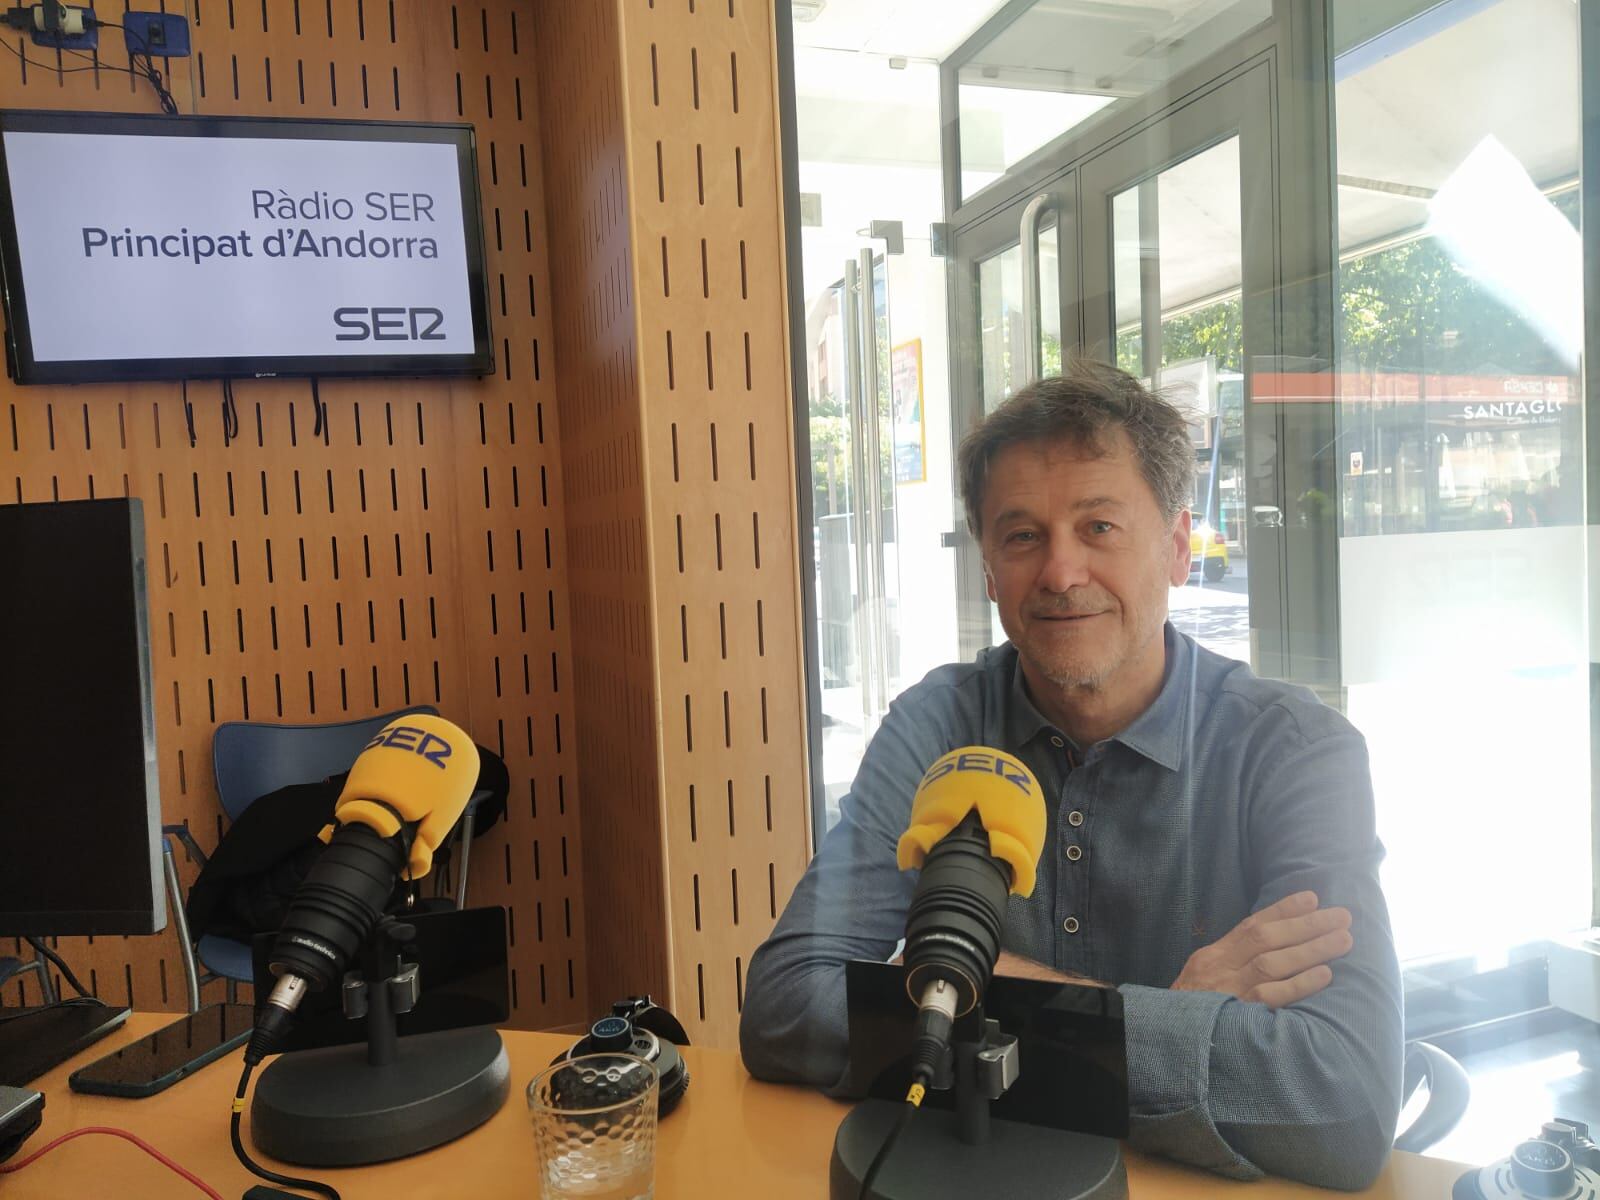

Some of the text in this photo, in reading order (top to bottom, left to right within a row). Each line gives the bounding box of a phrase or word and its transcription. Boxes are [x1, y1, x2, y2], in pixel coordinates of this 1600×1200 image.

[251, 189, 435, 222] Ràdio SER
[82, 227, 253, 265] Principat
[333, 307, 447, 341] SER
[922, 753, 1032, 796] SER
